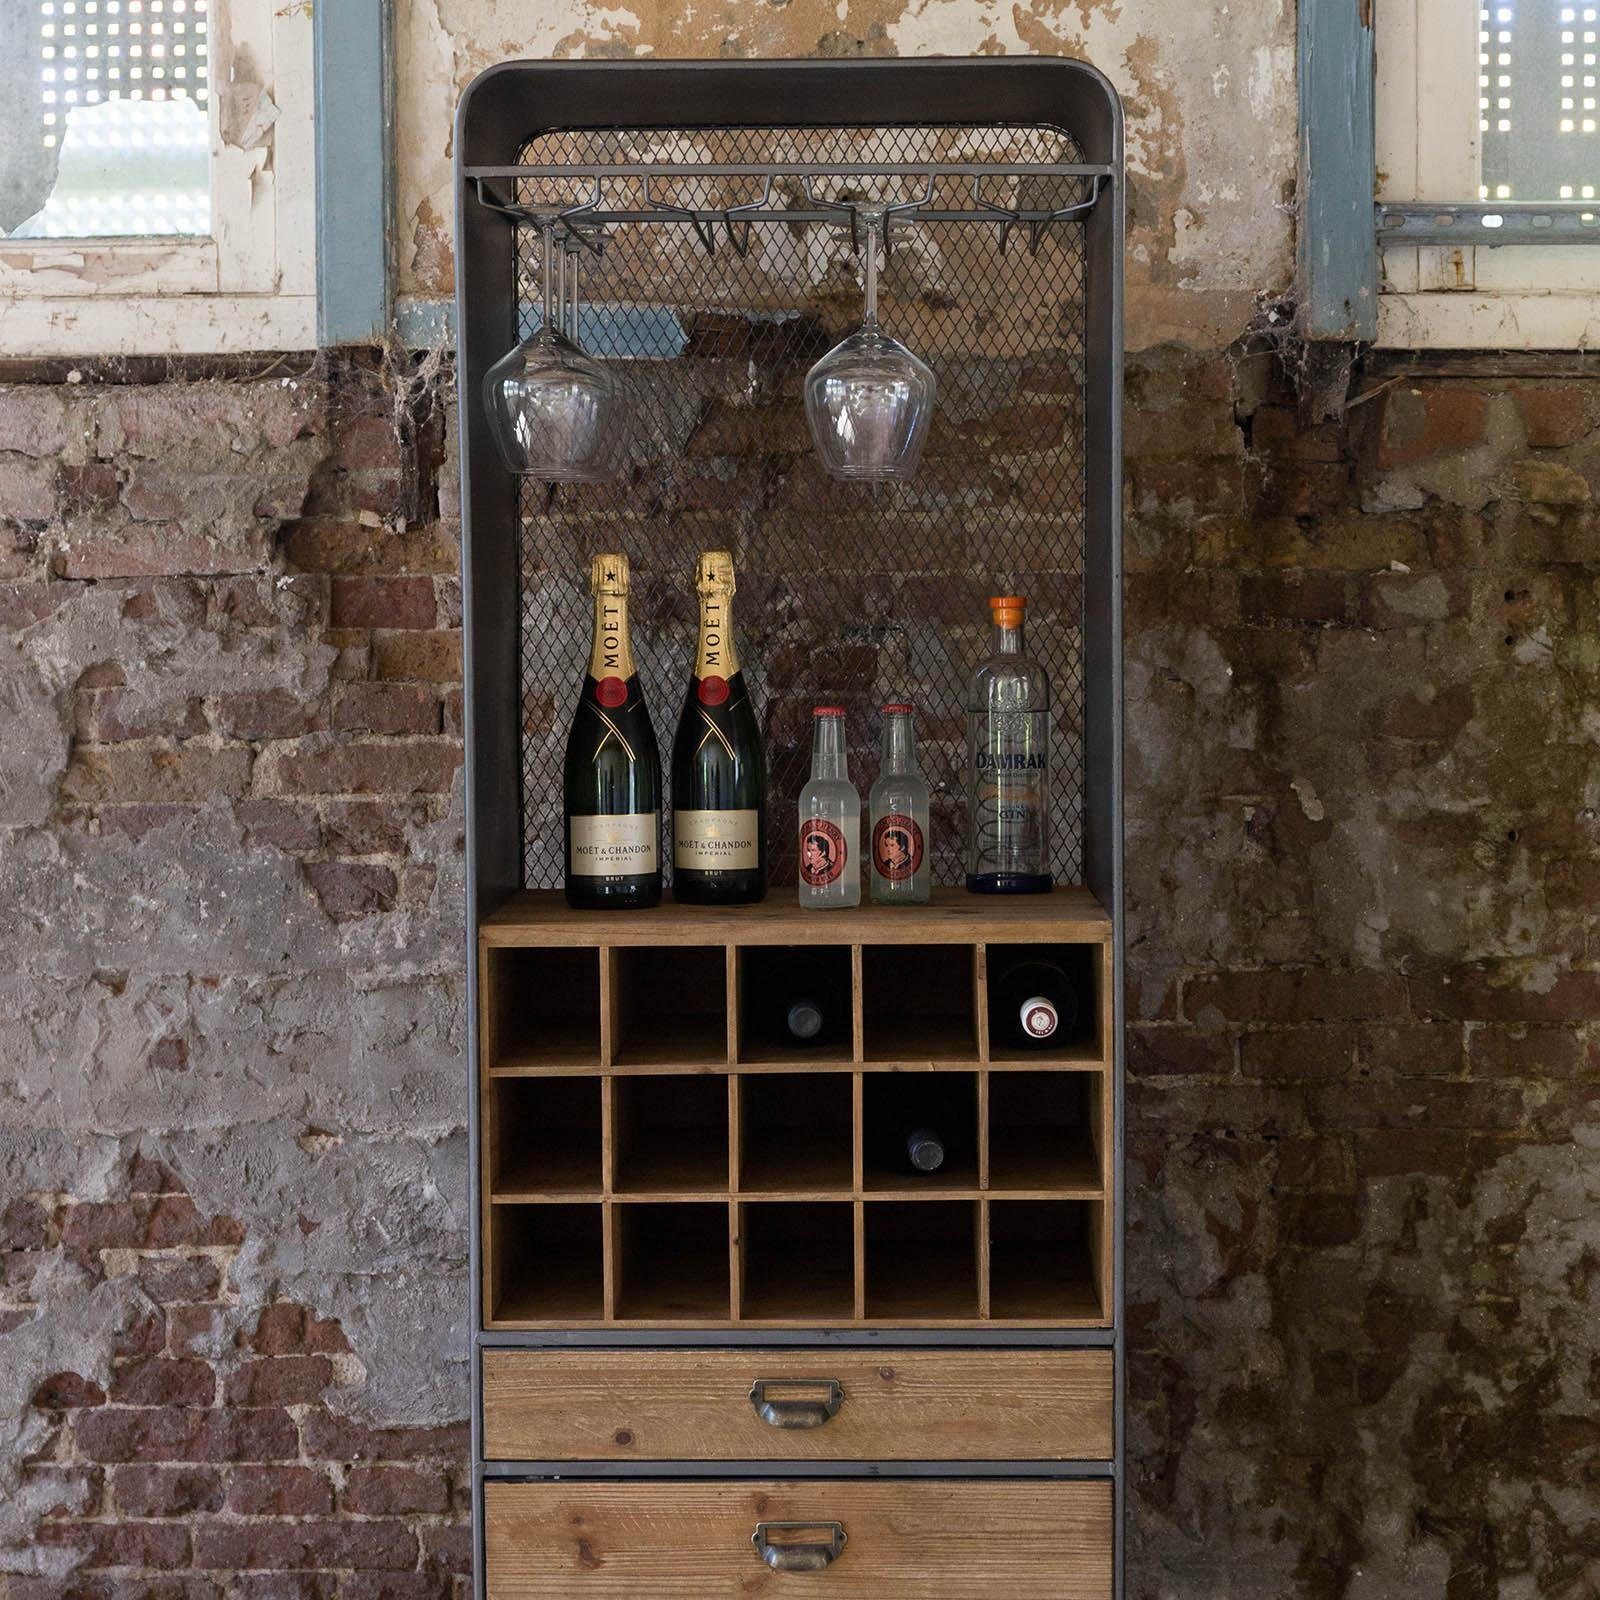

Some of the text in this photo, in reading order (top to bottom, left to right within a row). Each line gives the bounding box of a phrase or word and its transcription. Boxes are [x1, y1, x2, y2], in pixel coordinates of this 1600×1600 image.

[602, 605, 619, 669] MOËT
[704, 603, 721, 666] MOËT
[976, 752, 1047, 769] DAMRAK
[608, 844, 651, 855] CHANDON
[707, 840, 752, 849] CHANDON
